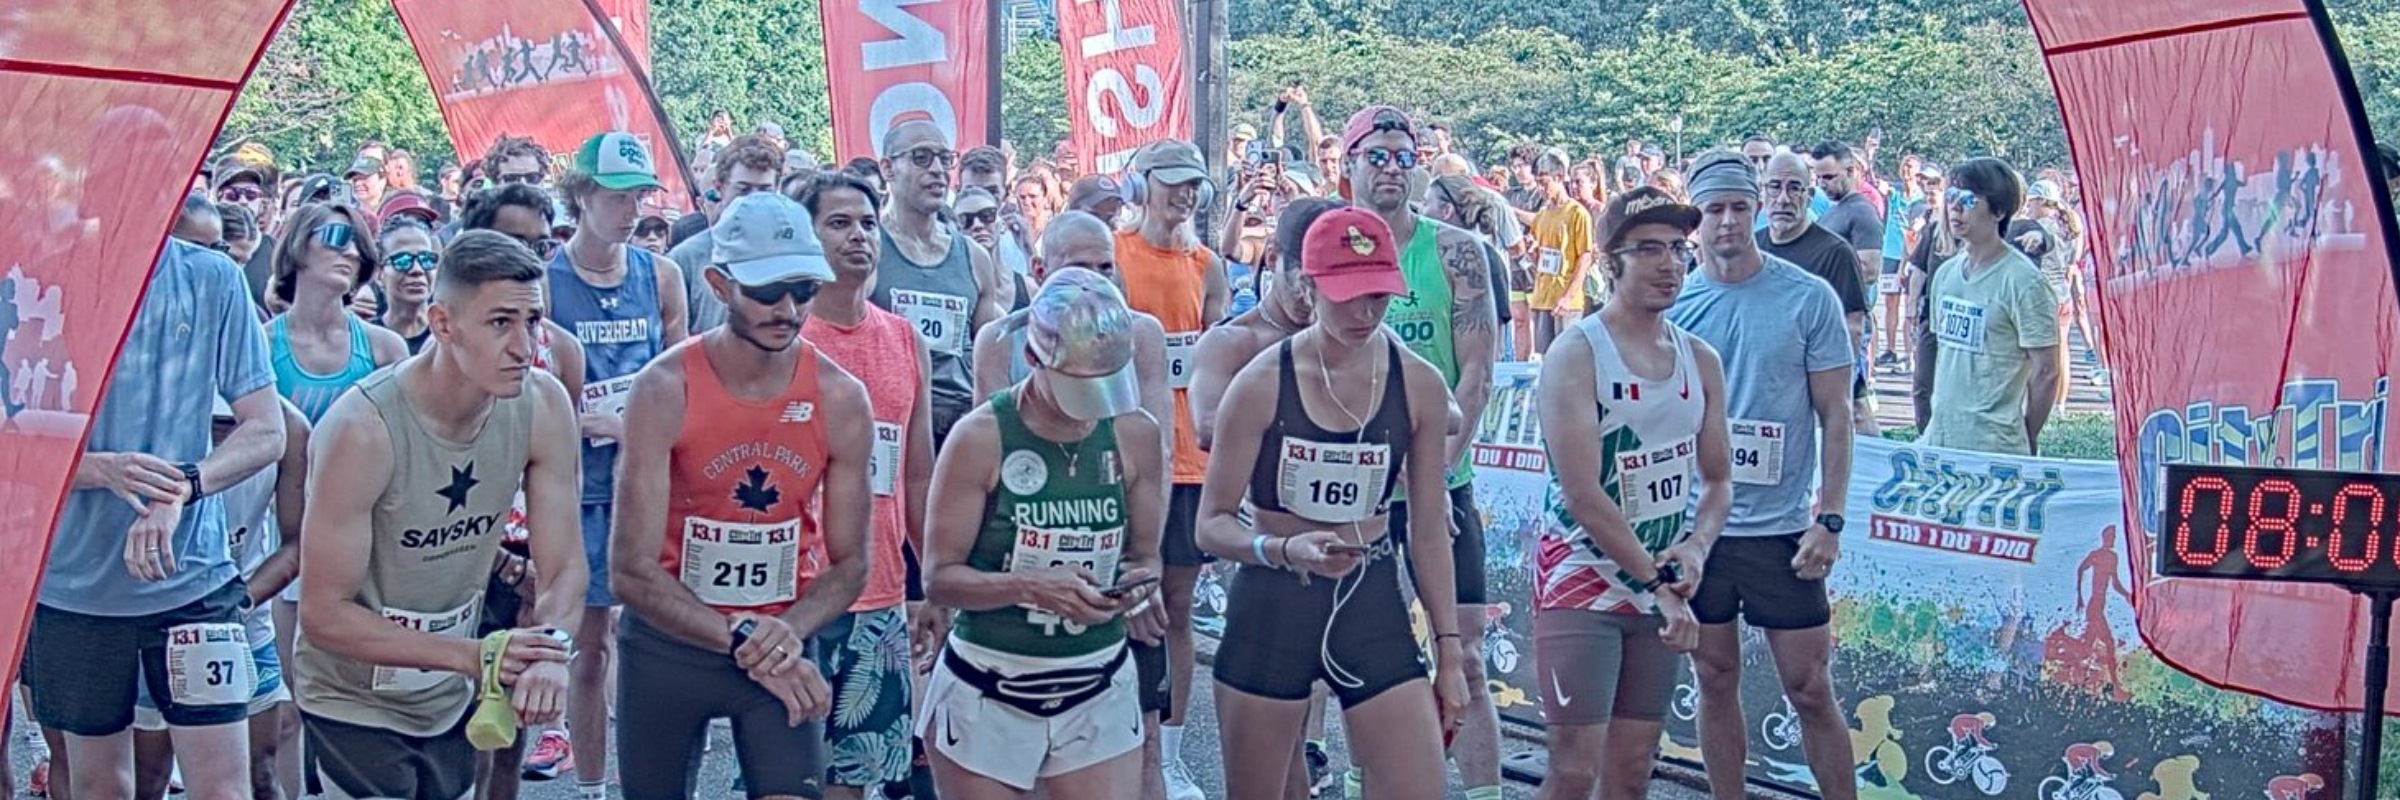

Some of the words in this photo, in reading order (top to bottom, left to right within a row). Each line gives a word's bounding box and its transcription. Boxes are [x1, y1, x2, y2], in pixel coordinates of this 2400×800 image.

[575, 317, 648, 344] RIVERHEAD
[920, 317, 942, 339] 20
[1945, 313, 1970, 338] 1079
[1760, 425, 1781, 439] 13.1
[703, 441, 773, 480] CENTRAL
[774, 444, 812, 478] PARK
[1287, 443, 1317, 463] 13.1
[1358, 450, 1384, 466] 13.1
[1514, 450, 1544, 470] DID
[1622, 453, 1647, 471] 13.1
[1730, 447, 1759, 467] 94
[1309, 480, 1359, 506] 169
[1647, 473, 1683, 503] 107
[1014, 497, 1118, 526] RUNNING
[400, 511, 501, 549] SAYSKY
[690, 522, 721, 543] 13.1
[766, 527, 795, 545] 13.1
[1020, 528, 1051, 550] 13.1
[713, 561, 768, 587] 215
[172, 629, 200, 645] 13.1
[206, 660, 234, 686] 37
